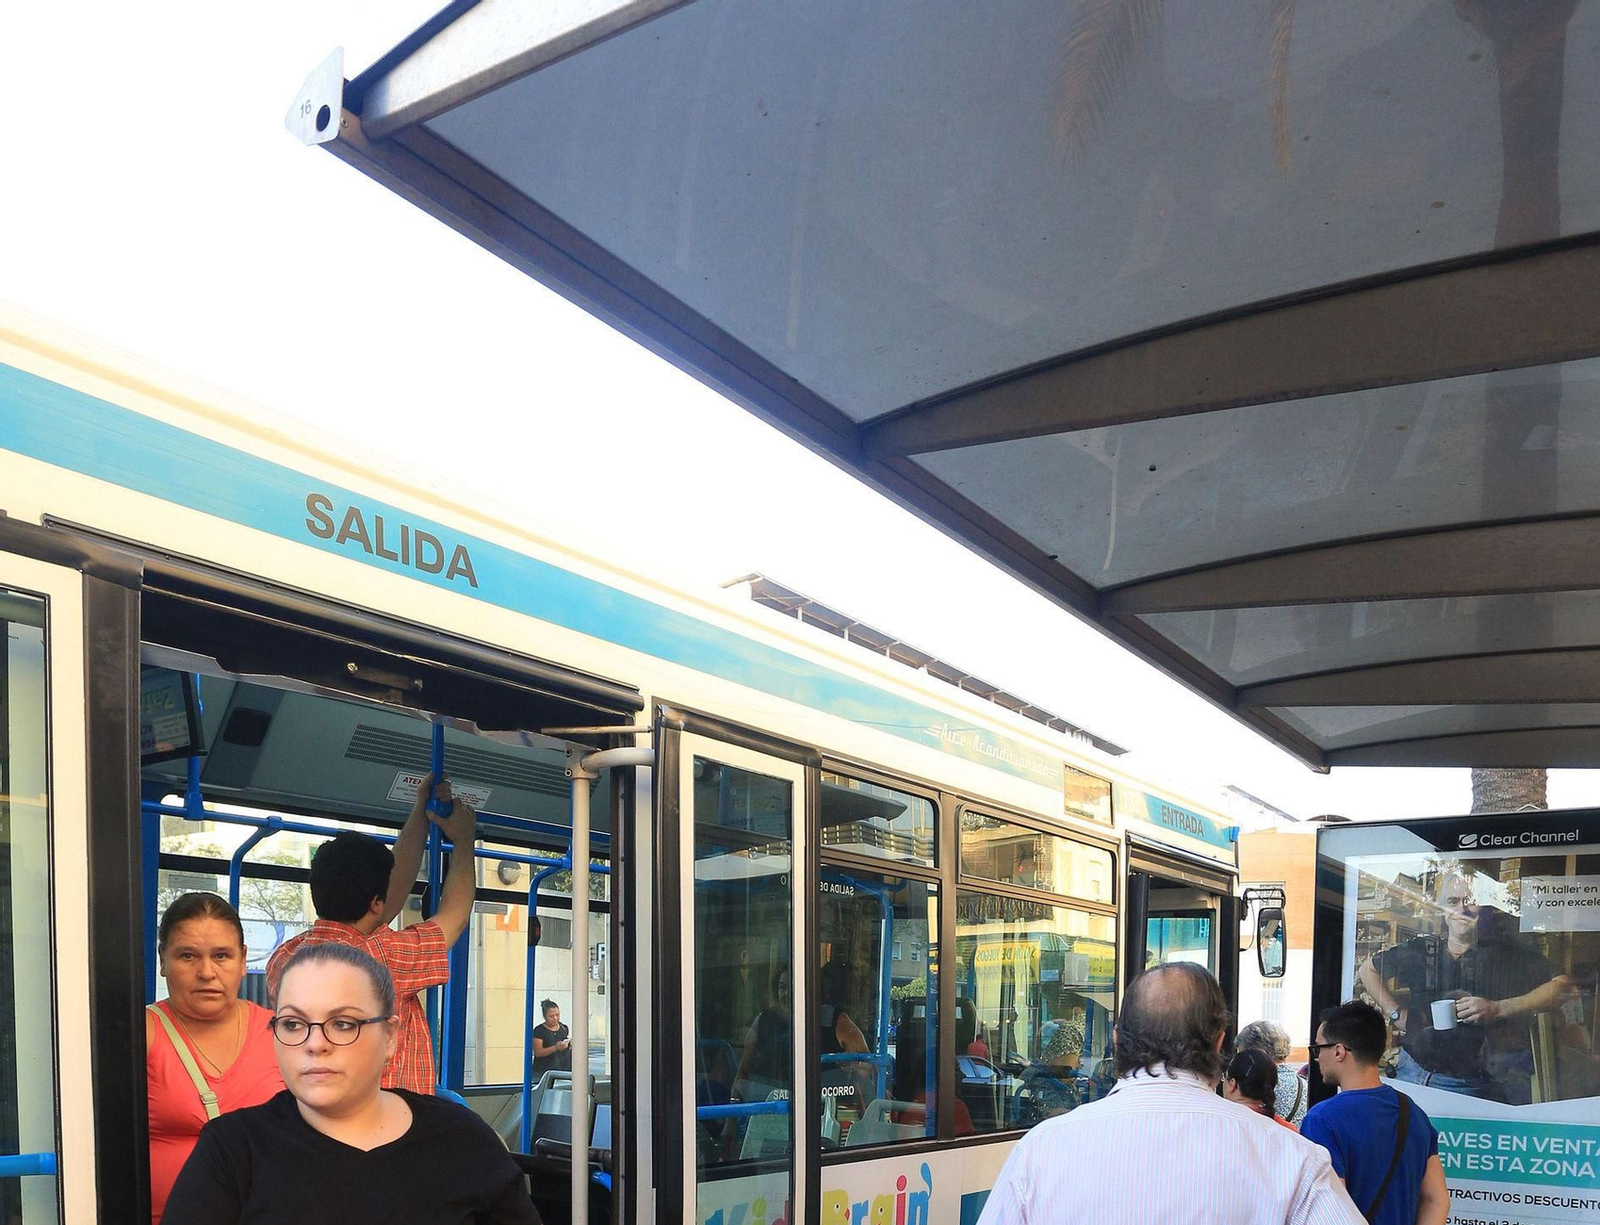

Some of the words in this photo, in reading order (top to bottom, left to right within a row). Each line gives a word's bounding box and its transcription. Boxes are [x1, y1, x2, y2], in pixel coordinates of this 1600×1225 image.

[300, 99, 312, 119] 16
[305, 493, 479, 589] SALIDA
[1161, 804, 1205, 837] ENTRADA
[1480, 834, 1517, 846] Clear
[1520, 829, 1579, 844] Channel
[1552, 885, 1581, 894] taller
[1537, 900, 1543, 909] y
[1497, 1134, 1527, 1152] EN
[1467, 1154, 1525, 1173] ESTA
[1529, 1158, 1596, 1179] ZONA
[1525, 1195, 1600, 1210] DESCUENT
